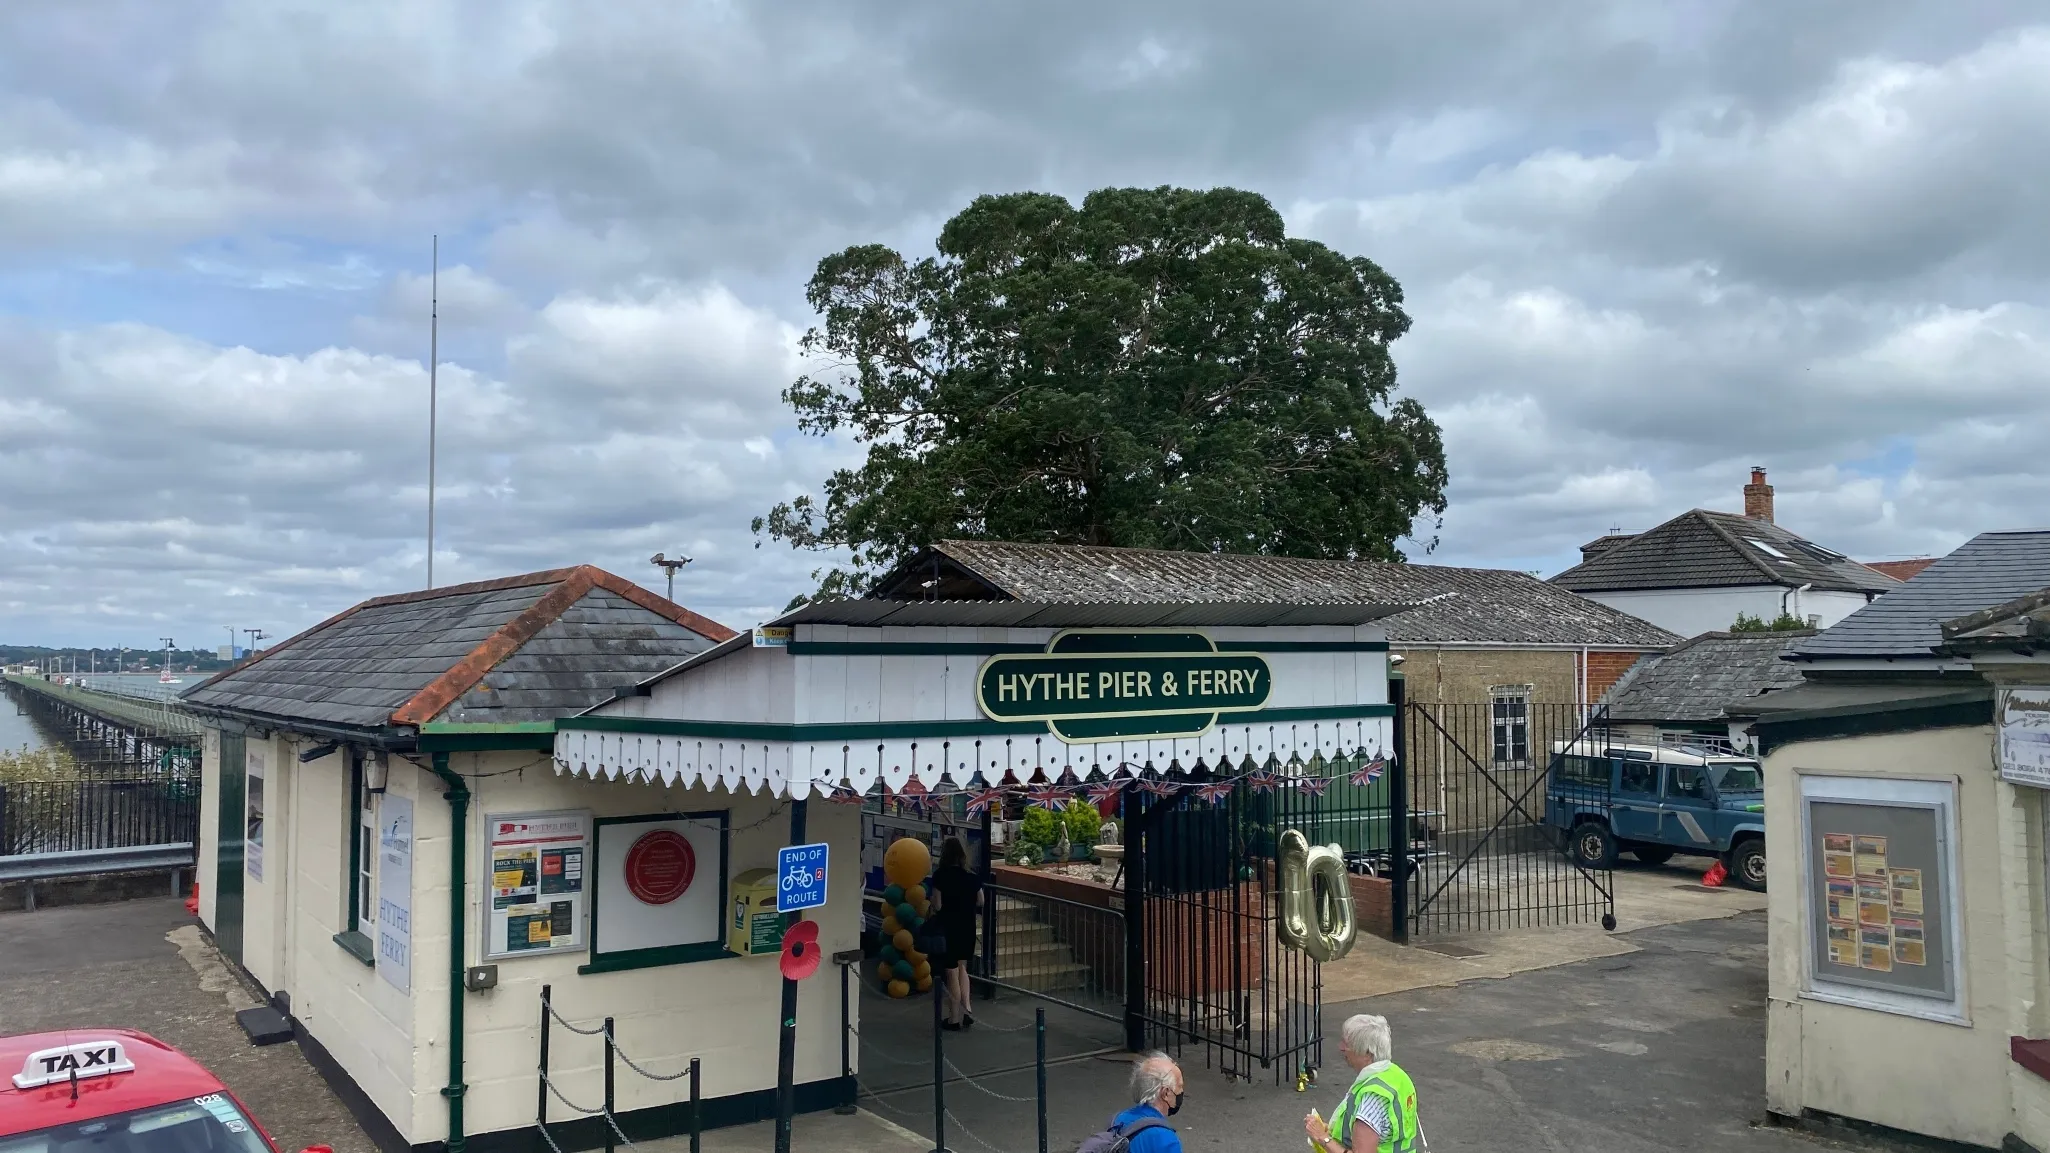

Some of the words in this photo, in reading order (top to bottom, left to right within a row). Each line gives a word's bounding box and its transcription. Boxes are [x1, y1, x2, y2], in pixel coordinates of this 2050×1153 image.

[998, 672, 1090, 702] HYTHE
[1098, 671, 1153, 699] PIER
[1160, 671, 1179, 696] &
[1187, 669, 1260, 695] FERRY
[785, 851, 807, 863] END
[809, 849, 822, 860] OF
[817, 870, 822, 879] 2
[786, 890, 818, 905] ROUTE
[379, 897, 409, 934] HYTHE
[380, 931, 407, 967] FERRY
[40, 1047, 116, 1074] TAXI
[193, 1094, 223, 1107] 028
